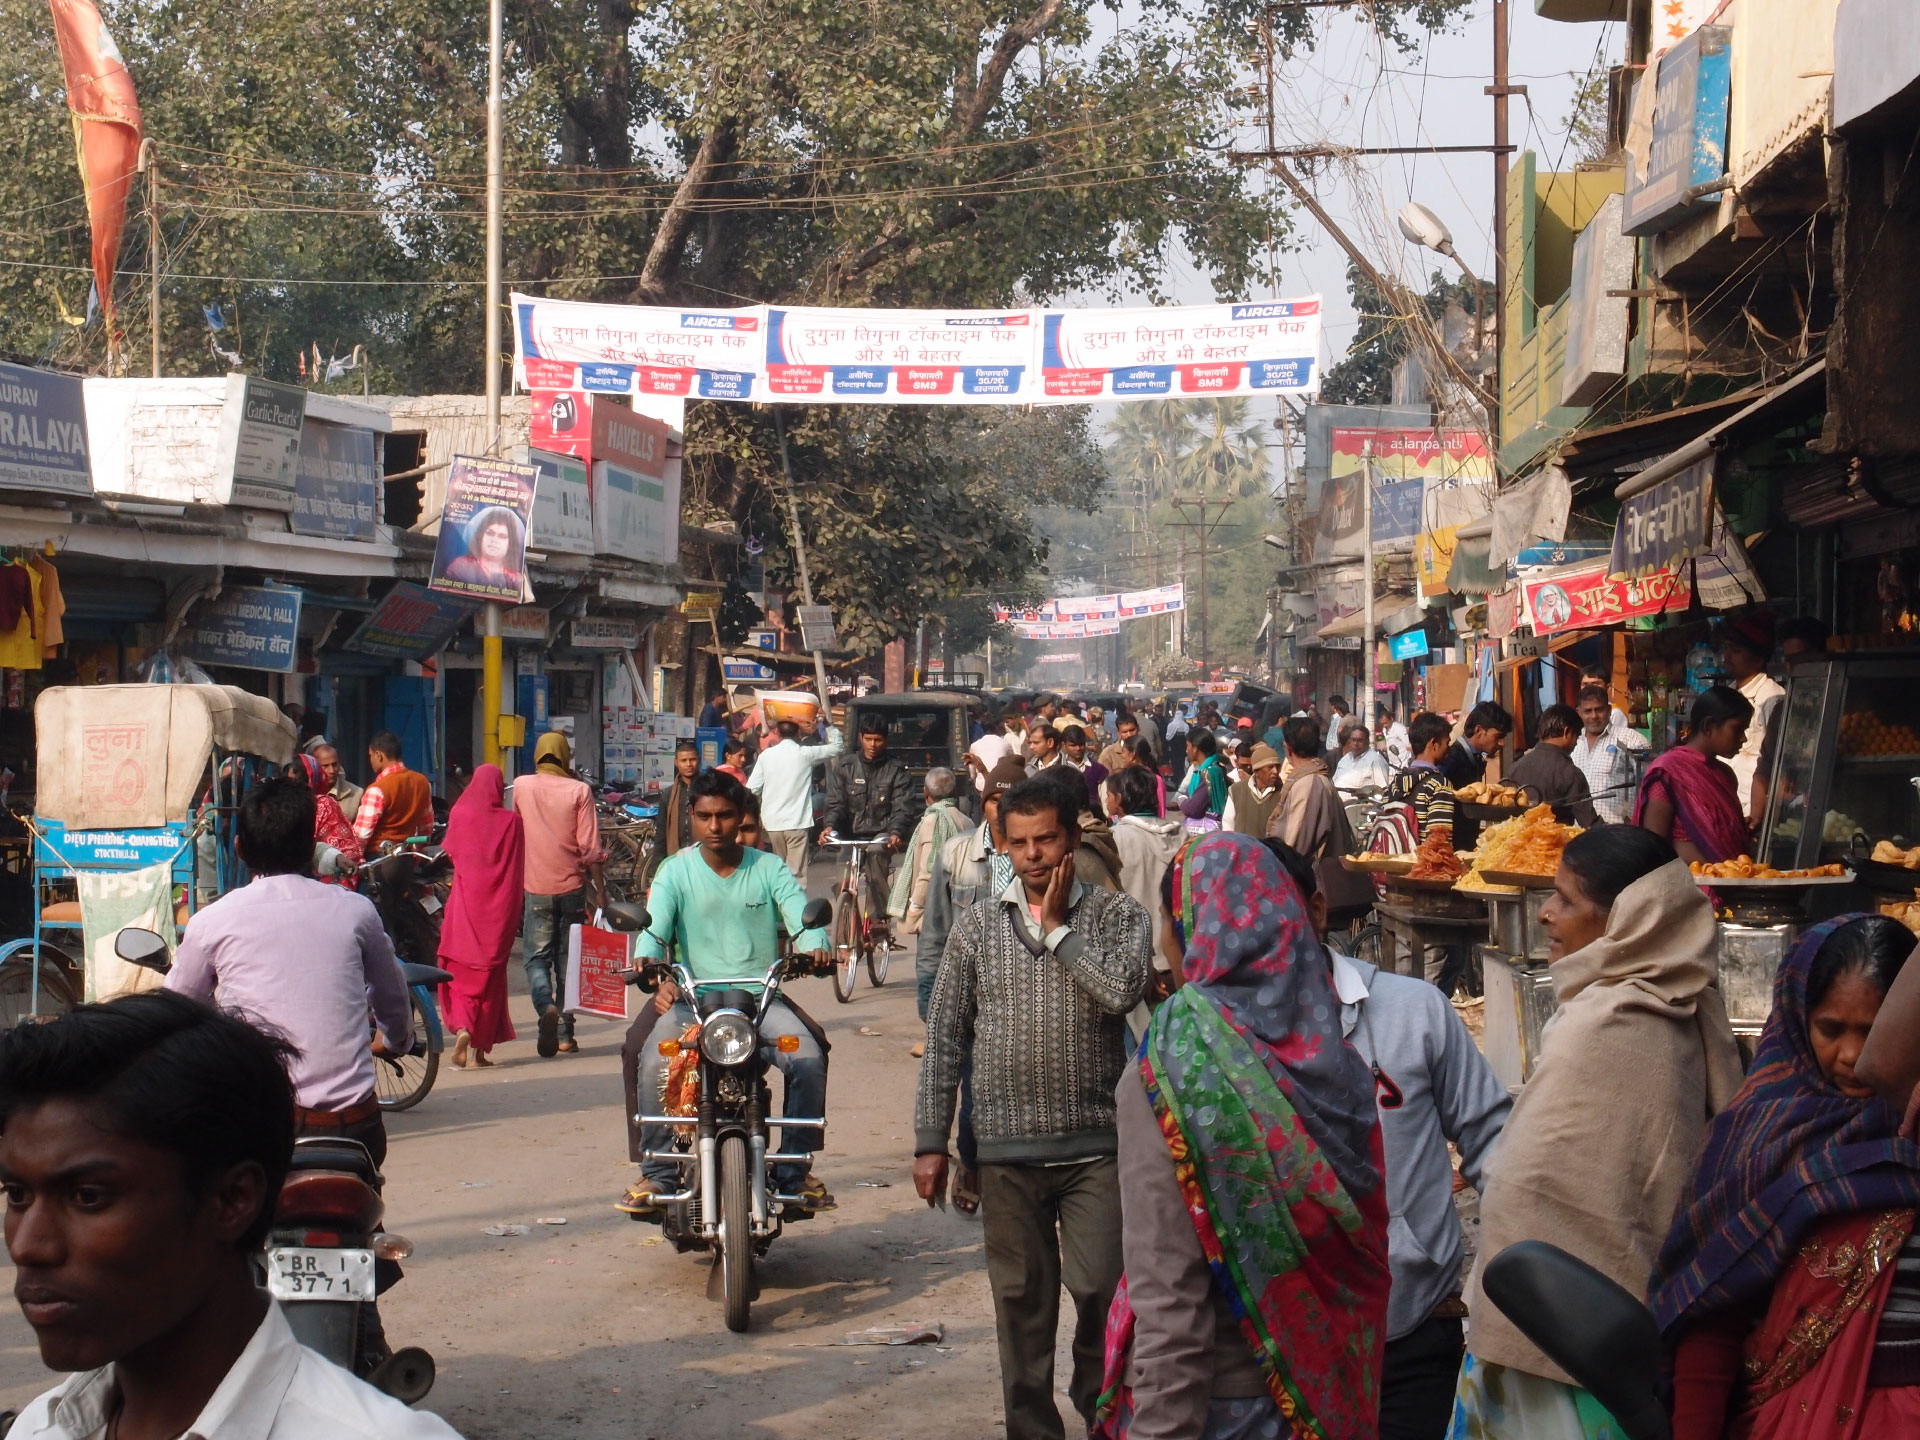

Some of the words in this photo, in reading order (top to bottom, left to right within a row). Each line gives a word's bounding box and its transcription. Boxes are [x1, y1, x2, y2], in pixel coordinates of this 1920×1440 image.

[1236, 304, 1290, 318] AIRCEL
[684, 316, 733, 329] AIRCEL
[552, 326, 589, 346] दुगुना
[596, 324, 637, 347] तिगुना
[646, 328, 713, 348] टॉकटाइम
[721, 331, 748, 349] पैक
[804, 328, 845, 347] दुगुना
[854, 325, 900, 348] तिगुना
[909, 325, 981, 343] टॉकटाइम
[989, 325, 1016, 343] पैक
[1083, 331, 1126, 350] दुगुना
[1135, 326, 1184, 347] तिगुना
[1193, 323, 1268, 340] टॉकटाइम
[1278, 318, 1308, 335] पैक
[855, 345, 883, 362] और
[893, 345, 909, 363] भी
[918, 347, 962, 363] बेहतर
[1136, 348, 1166, 363] और
[1176, 344, 1194, 360] भी
[1204, 344, 1249, 360] बेहतर
[653, 381, 676, 391] SMS
[713, 381, 737, 389] 3G/2G
[913, 381, 937, 390] SMS
[978, 377, 1004, 385] 3G/2G
[1197, 378, 1223, 387] SMS
[247, 400, 272, 423] Garlic
[273, 404, 297, 427] Pearls
[607, 420, 655, 462] HAVELLS
[1571, 574, 1623, 616] साई
[239, 604, 271, 621] MEDICAL
[273, 607, 293, 624] HALL
[226, 629, 267, 652] मेडिकल
[268, 634, 291, 655] हॉल
[1509, 643, 1538, 656] Tea
[85, 727, 146, 760] लुना
[291, 1256, 317, 1271] BR
[292, 1277, 351, 1293] 3771
